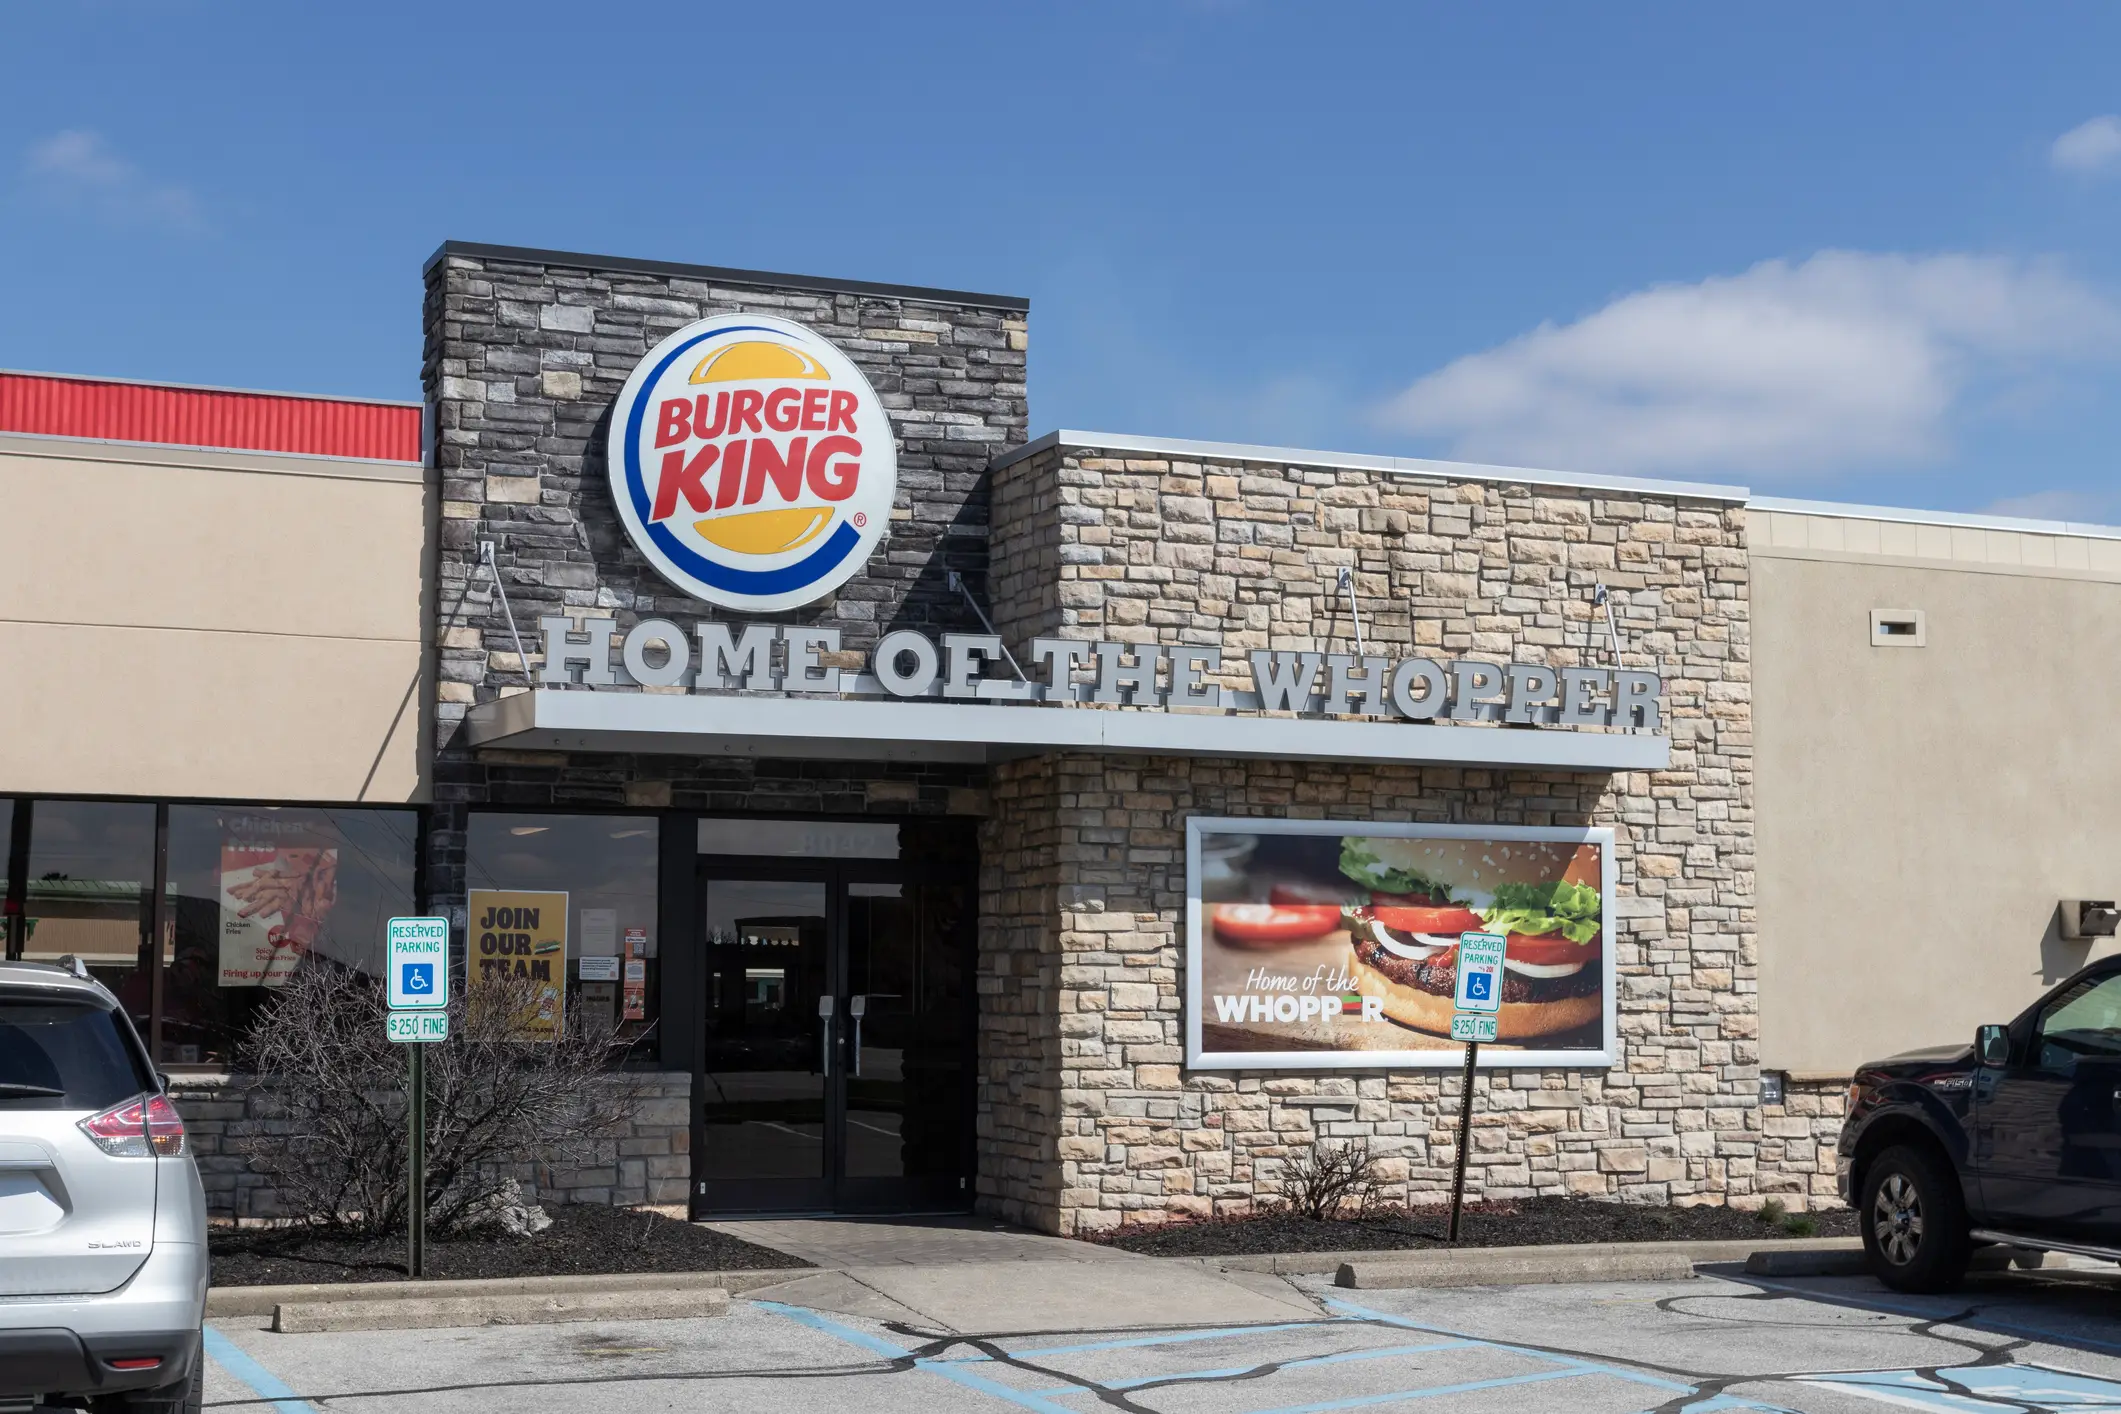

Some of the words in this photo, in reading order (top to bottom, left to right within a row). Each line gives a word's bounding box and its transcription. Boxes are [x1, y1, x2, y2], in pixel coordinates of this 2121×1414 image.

[654, 387, 859, 450] BURGER
[652, 435, 863, 521] KING
[537, 615, 842, 692] HOME
[871, 628, 1002, 698] OF
[1032, 636, 1222, 708] THE
[1246, 648, 1664, 728] WHOPPER
[480, 906, 540, 930] JOIN
[393, 926, 443, 938] RESERVED
[395, 941, 440, 953] PARKING
[480, 932, 532, 956] OUR
[1463, 939, 1502, 952] RESERVED
[1464, 953, 1499, 965] PARKING
[223, 969, 248, 979] Firing
[250, 971, 261, 979] up
[262, 971, 283, 979] your
[479, 959, 550, 982] TEAM
[1246, 967, 1297, 991] Home
[1302, 964, 1326, 995] of
[1326, 965, 1360, 991] the
[390, 1017, 419, 1035] $250
[423, 1018, 445, 1035] FINE
[1453, 1018, 1476, 1035] $250
[1478, 1019, 1496, 1036] FINE
